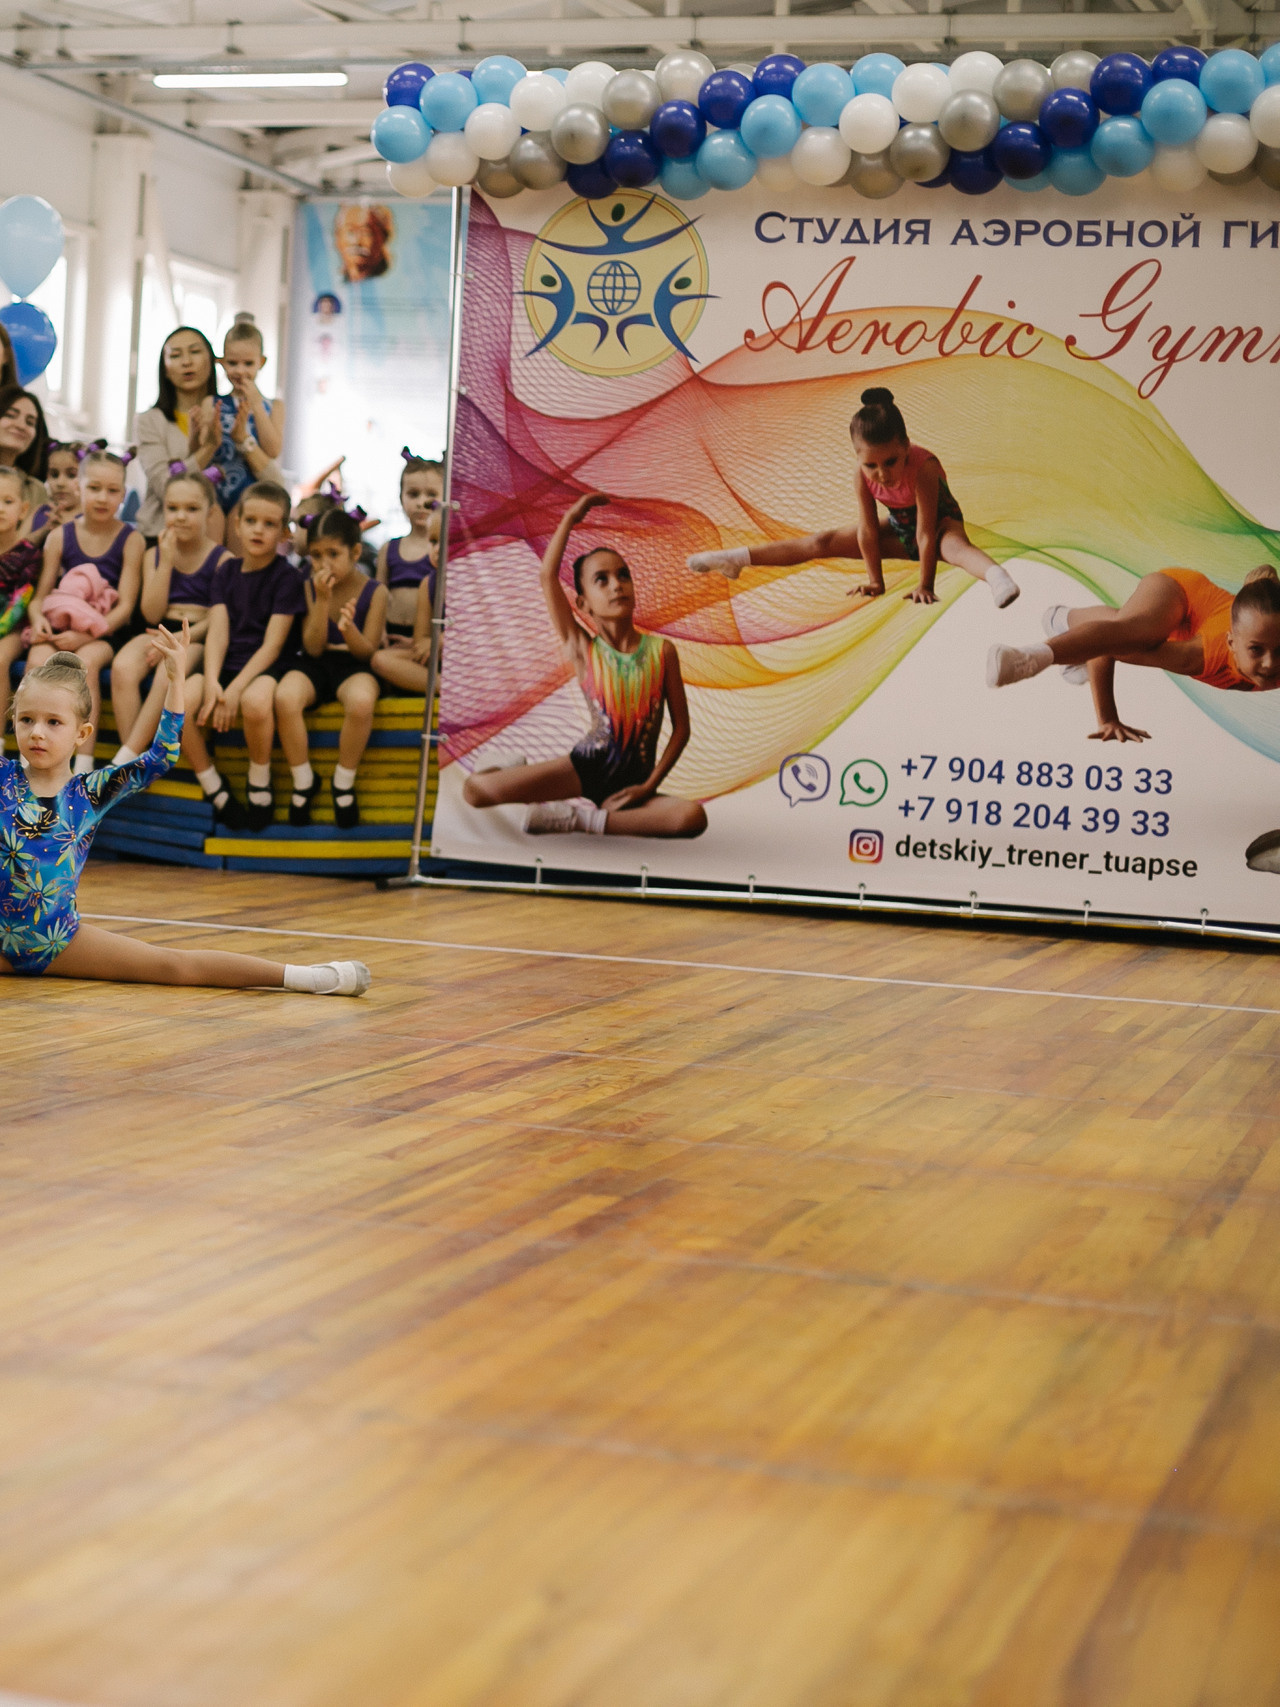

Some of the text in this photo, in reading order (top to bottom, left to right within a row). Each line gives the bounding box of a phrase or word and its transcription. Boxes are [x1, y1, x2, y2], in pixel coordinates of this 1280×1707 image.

[744, 256, 1043, 360] Aerobic
[901, 755, 1173, 795] +7 904 883 03 33
[898, 796, 1170, 837] +7 918 204 39 33
[895, 834, 1198, 881] detskiy_trener_tuapse
